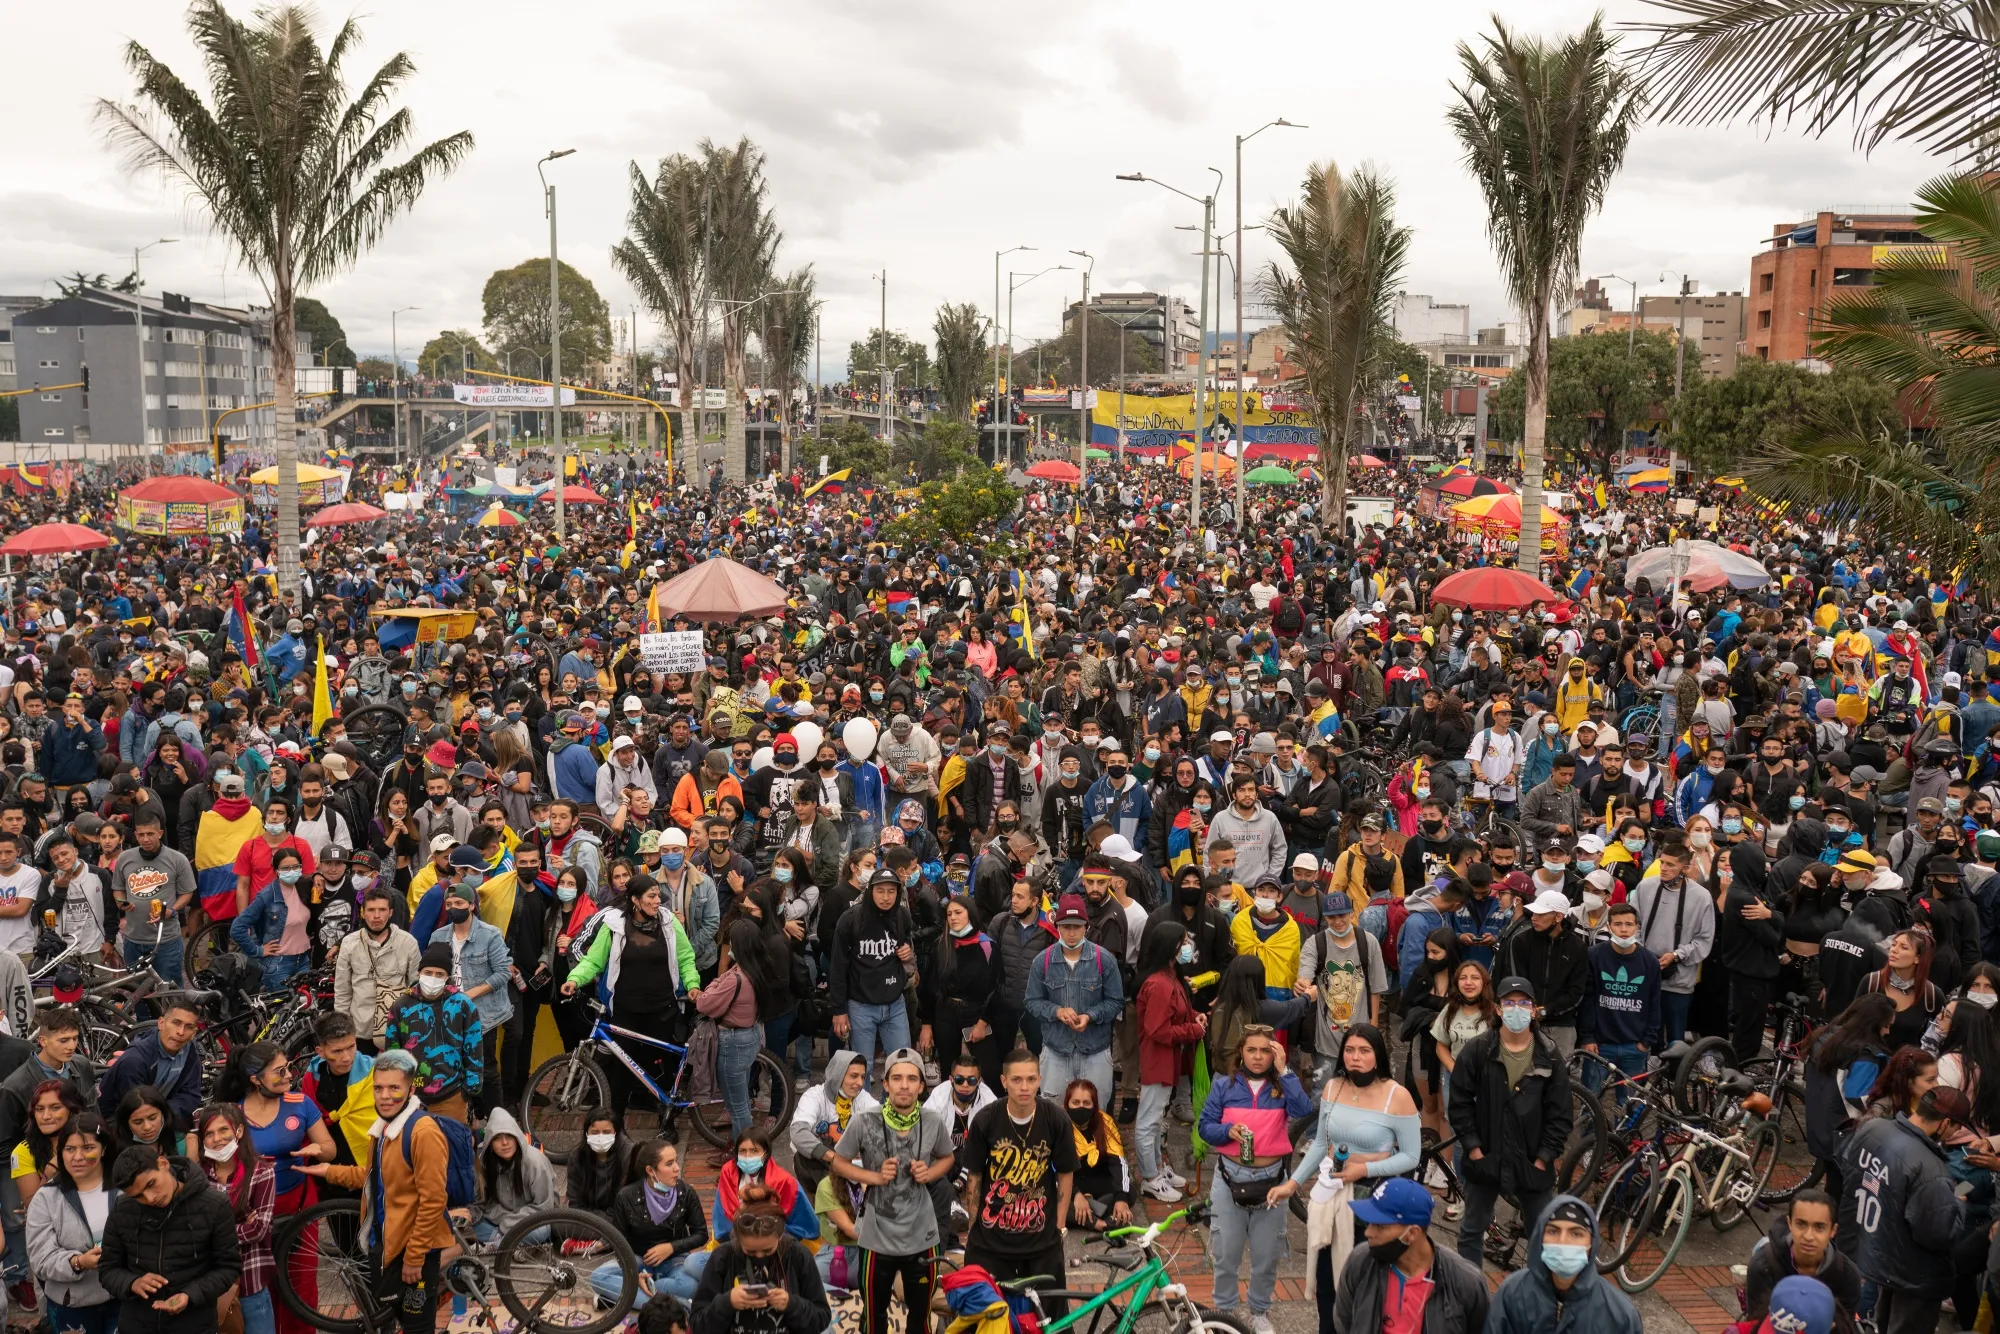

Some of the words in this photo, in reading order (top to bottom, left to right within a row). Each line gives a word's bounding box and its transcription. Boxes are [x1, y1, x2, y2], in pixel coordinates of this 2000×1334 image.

[1115, 411, 1184, 431] ABUNDAN
[1255, 428, 1320, 446] LADRONE
[138, 887, 160, 897] STORE
[1824, 938, 1865, 958] SUPREME
[1604, 981, 1639, 993] adidas
[1599, 994, 1643, 1010] ORIGINALS
[1858, 1147, 1889, 1186] USA
[1854, 1187, 1882, 1233] 10
